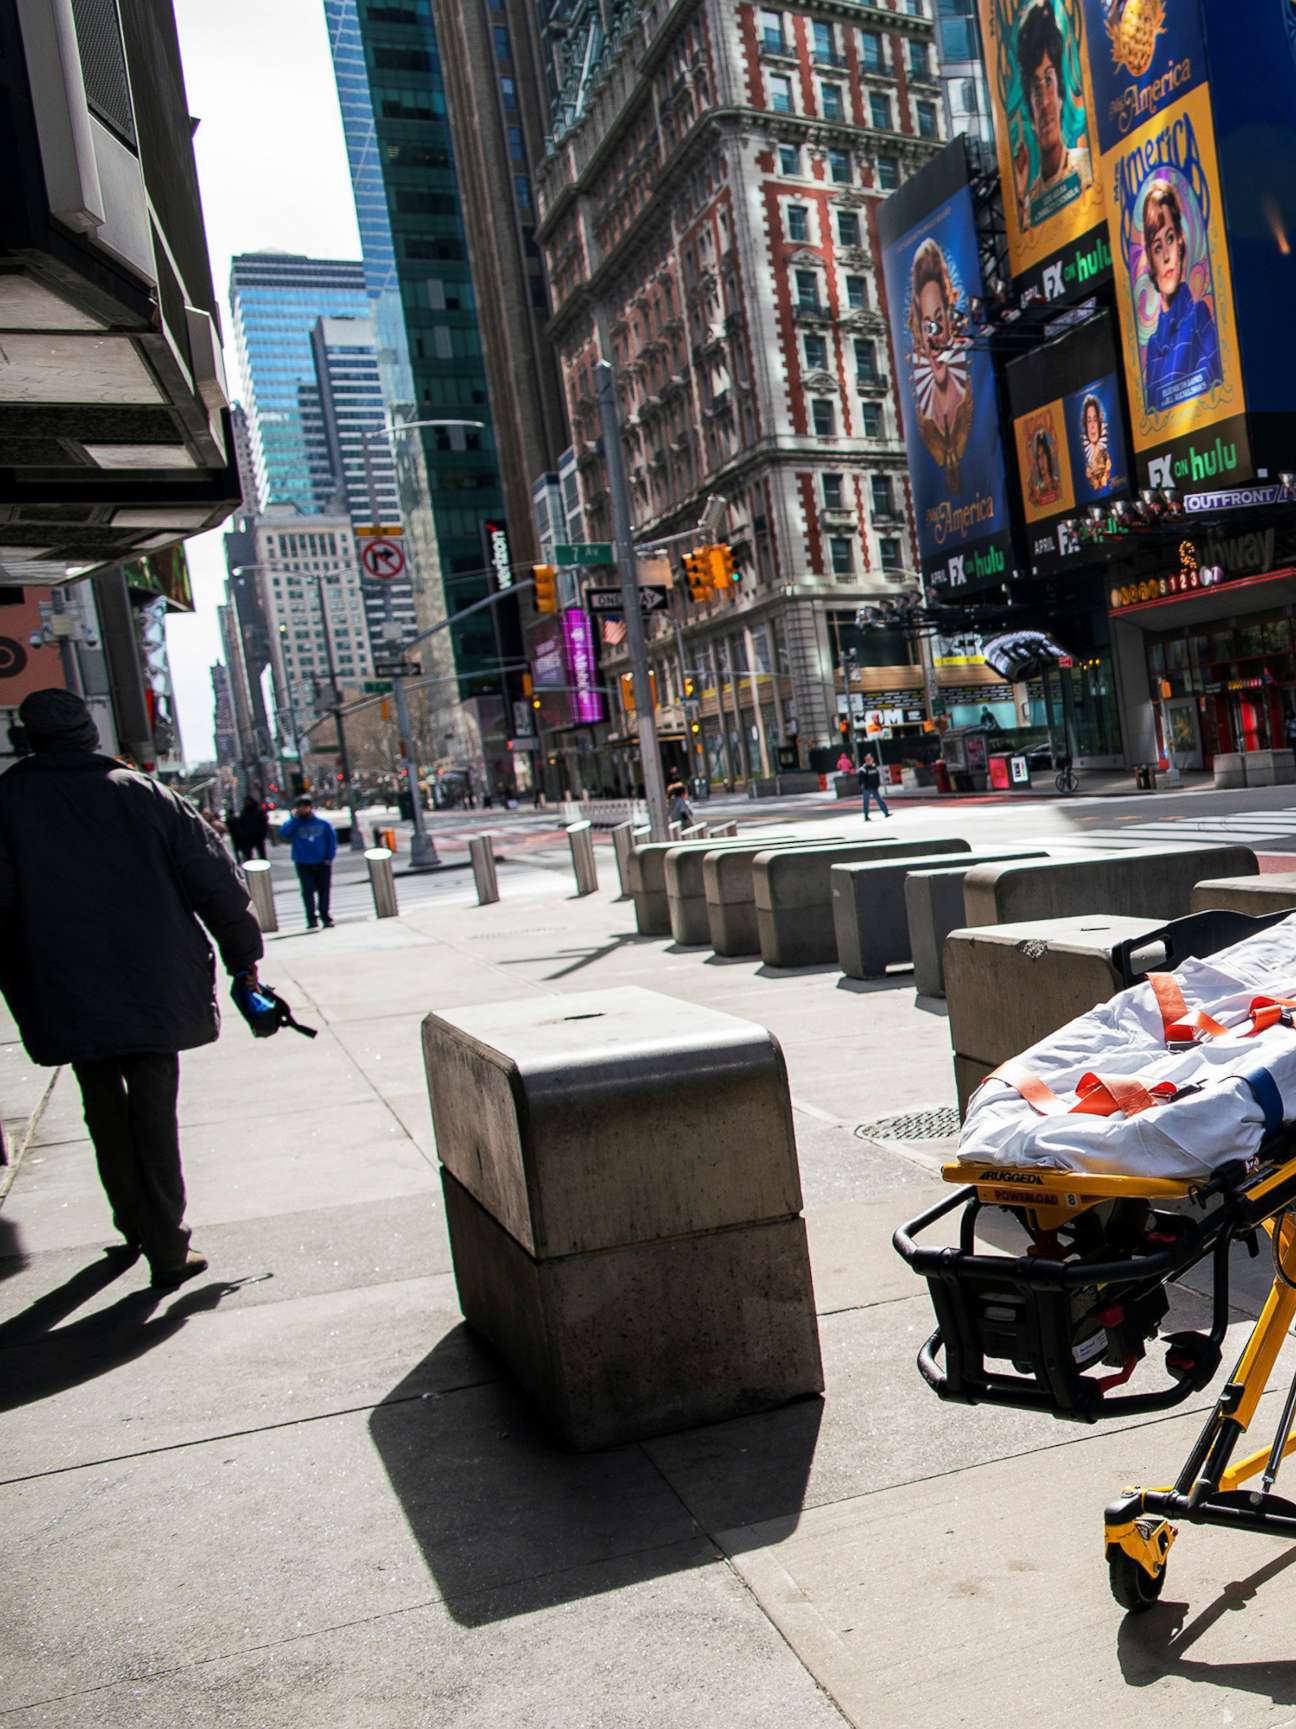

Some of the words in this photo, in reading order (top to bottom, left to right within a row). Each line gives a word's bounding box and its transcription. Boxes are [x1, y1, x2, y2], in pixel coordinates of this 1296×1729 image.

[1043, 260, 1066, 302] FX
[1148, 454, 1176, 489] FX
[1174, 460, 1188, 478] ON
[1190, 438, 1237, 481] hulu
[1188, 487, 1275, 511] OUTFRONT
[571, 546, 580, 562] 7
[948, 554, 967, 587] FX
[974, 545, 1005, 577] hulu
